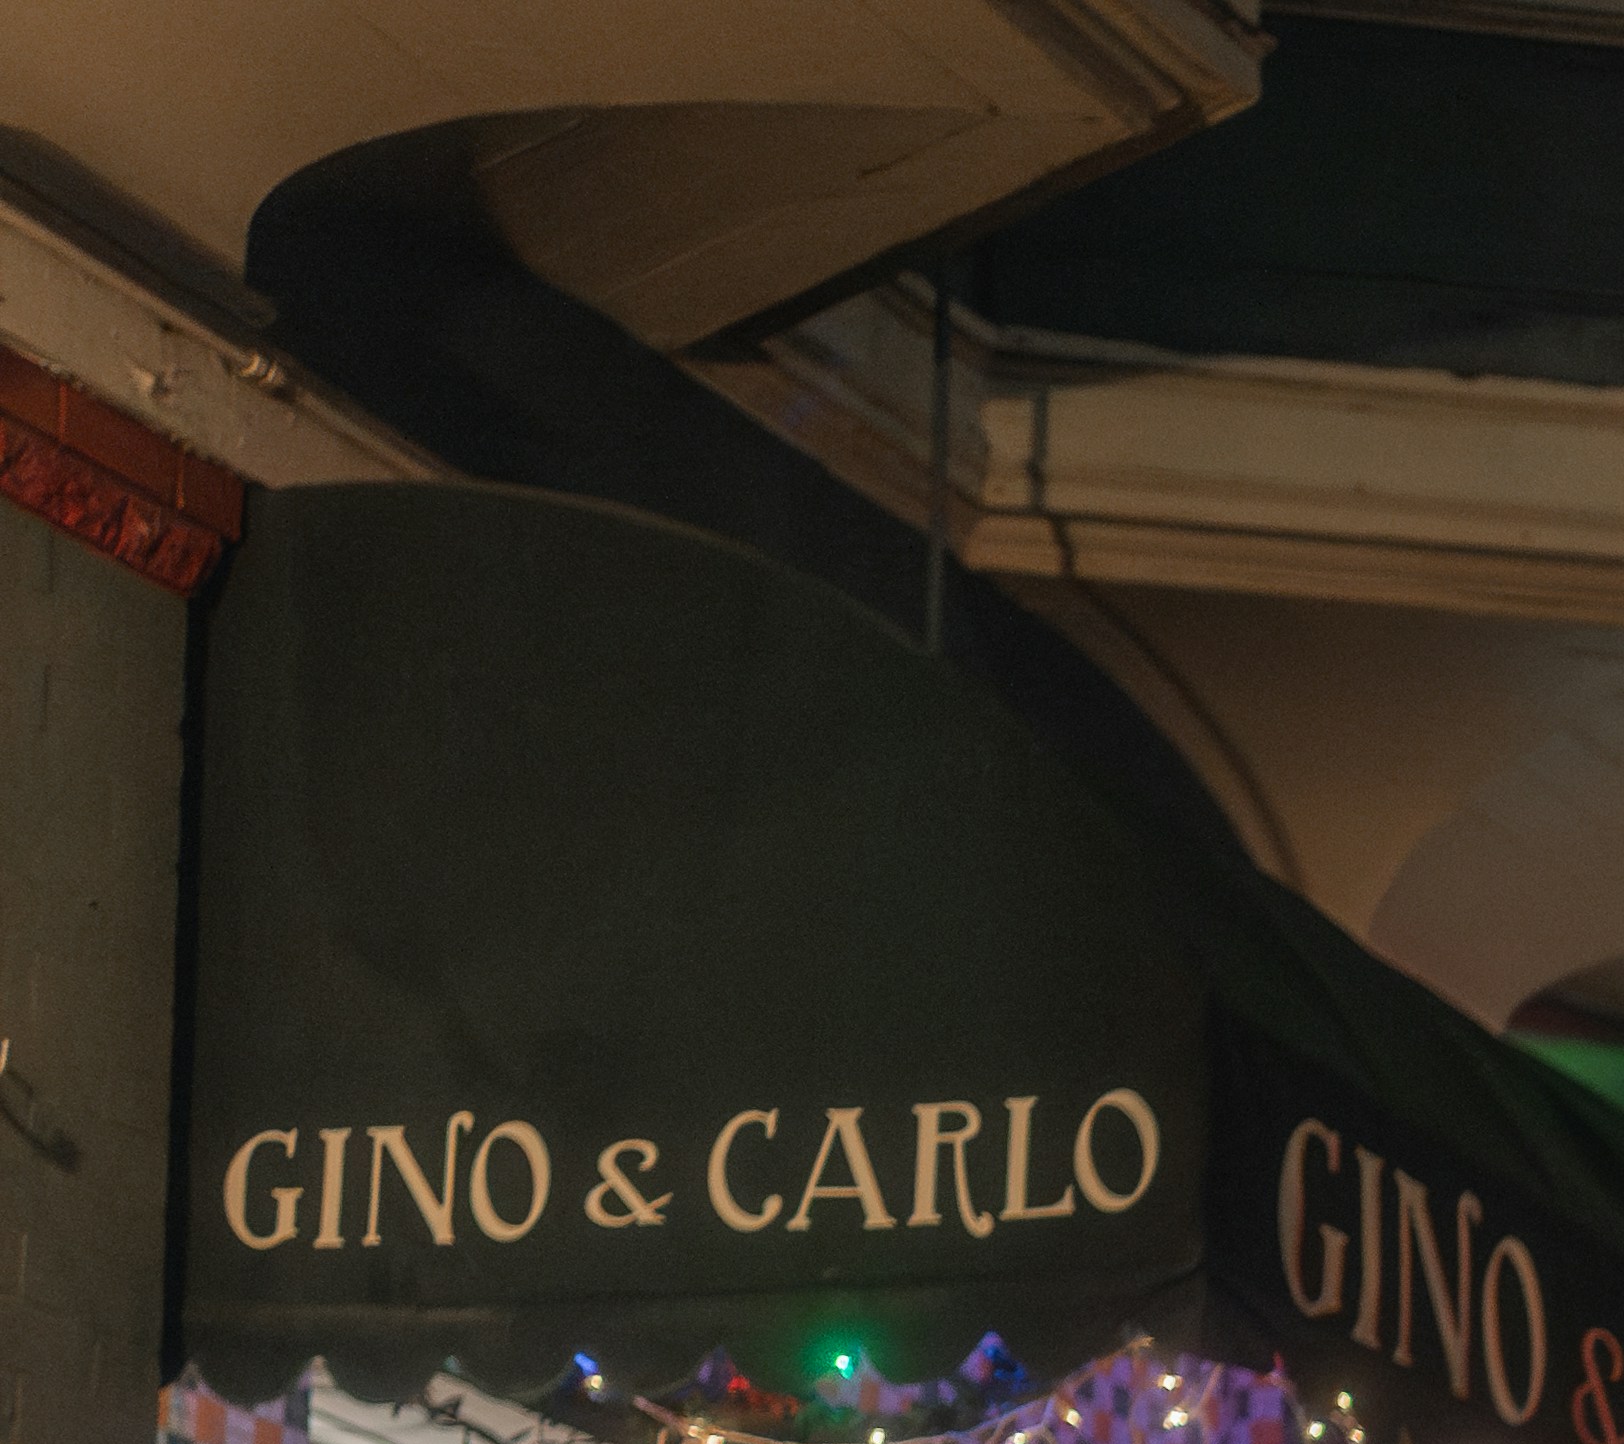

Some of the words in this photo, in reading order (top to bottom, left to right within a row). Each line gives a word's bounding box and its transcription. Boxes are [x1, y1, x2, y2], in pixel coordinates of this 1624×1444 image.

[221, 1108, 553, 1251] GINO
[583, 1136, 675, 1230] &
[705, 1086, 1162, 1240] CARLO
[1275, 1116, 1548, 1428] GINO
